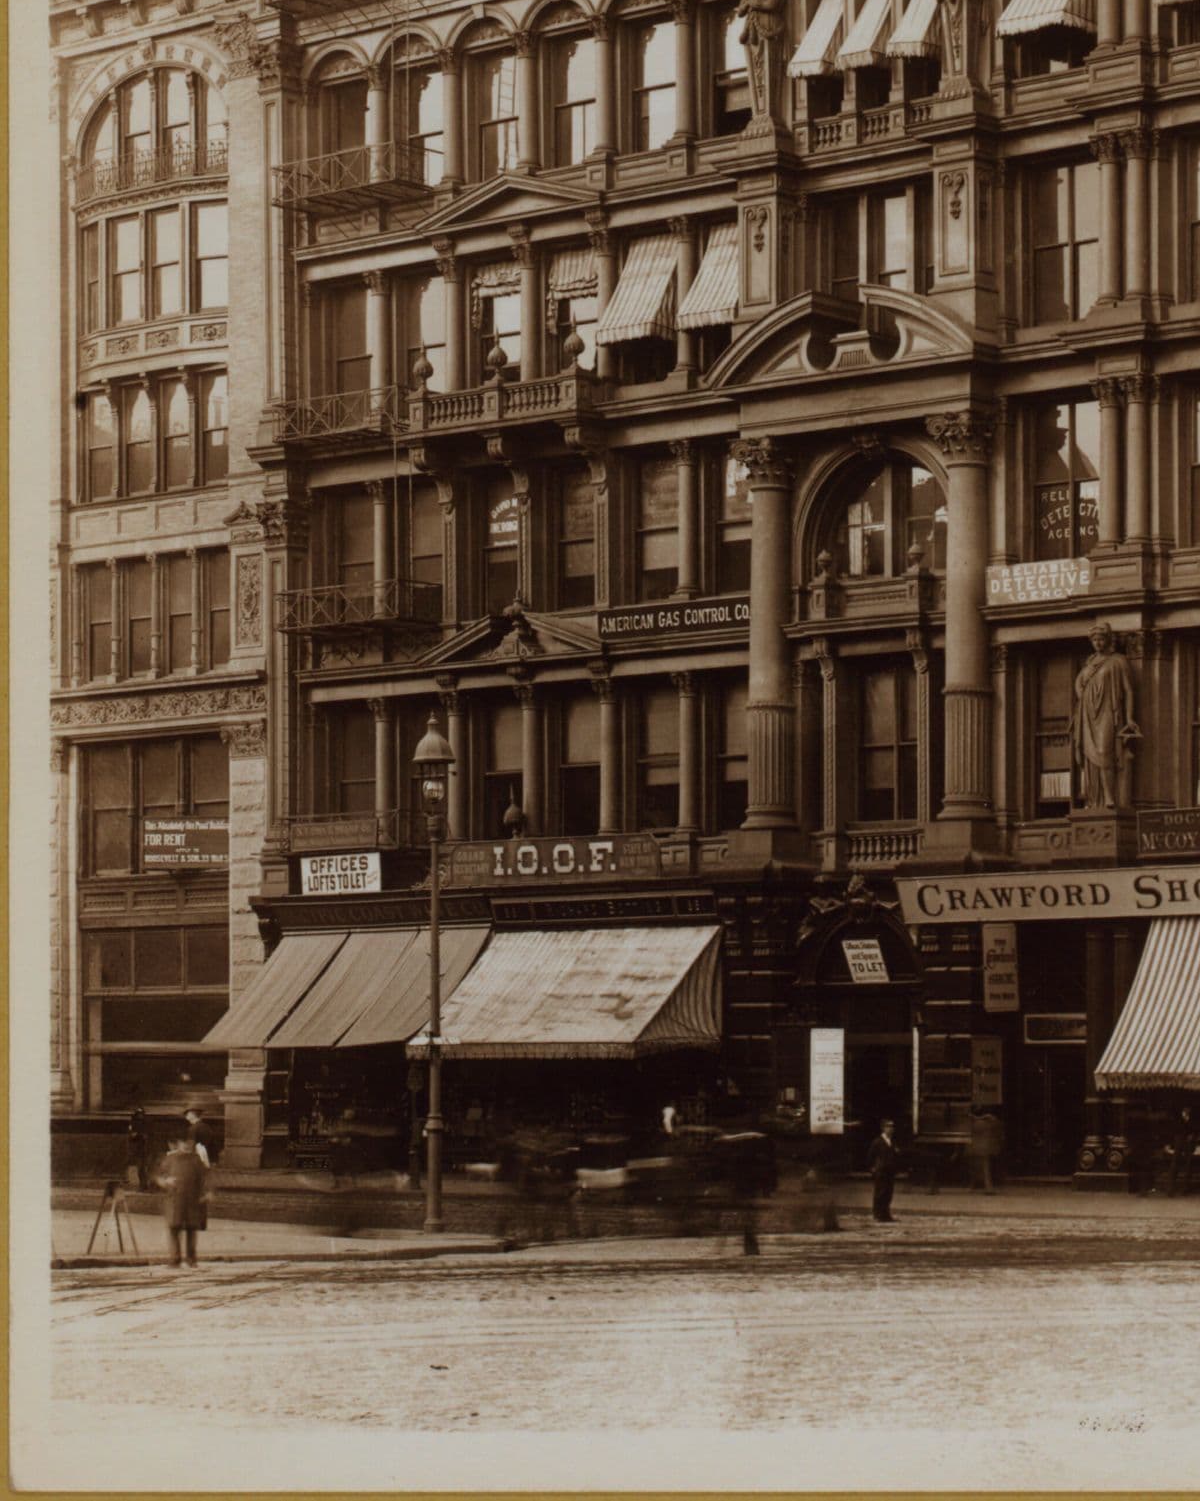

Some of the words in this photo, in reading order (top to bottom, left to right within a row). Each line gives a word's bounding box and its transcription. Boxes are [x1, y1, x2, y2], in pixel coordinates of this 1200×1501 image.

[1041, 502, 1100, 530] DETECTI
[990, 569, 1091, 594] DETECTIVE
[601, 616, 654, 634] AMERICAN
[658, 611, 680, 628] GAS
[684, 606, 731, 625] CONTROL
[144, 833, 162, 846] FOR
[163, 833, 186, 846] RENT
[310, 855, 369, 875] OFFICES
[493, 841, 617, 876] I.O.O.F.
[308, 874, 336, 892] LOFTS
[337, 873, 349, 890] TO
[350, 872, 367, 889] LET
[916, 883, 1112, 918] CRAWFORD
[852, 962, 865, 973] TO
[866, 962, 884, 972] LET
